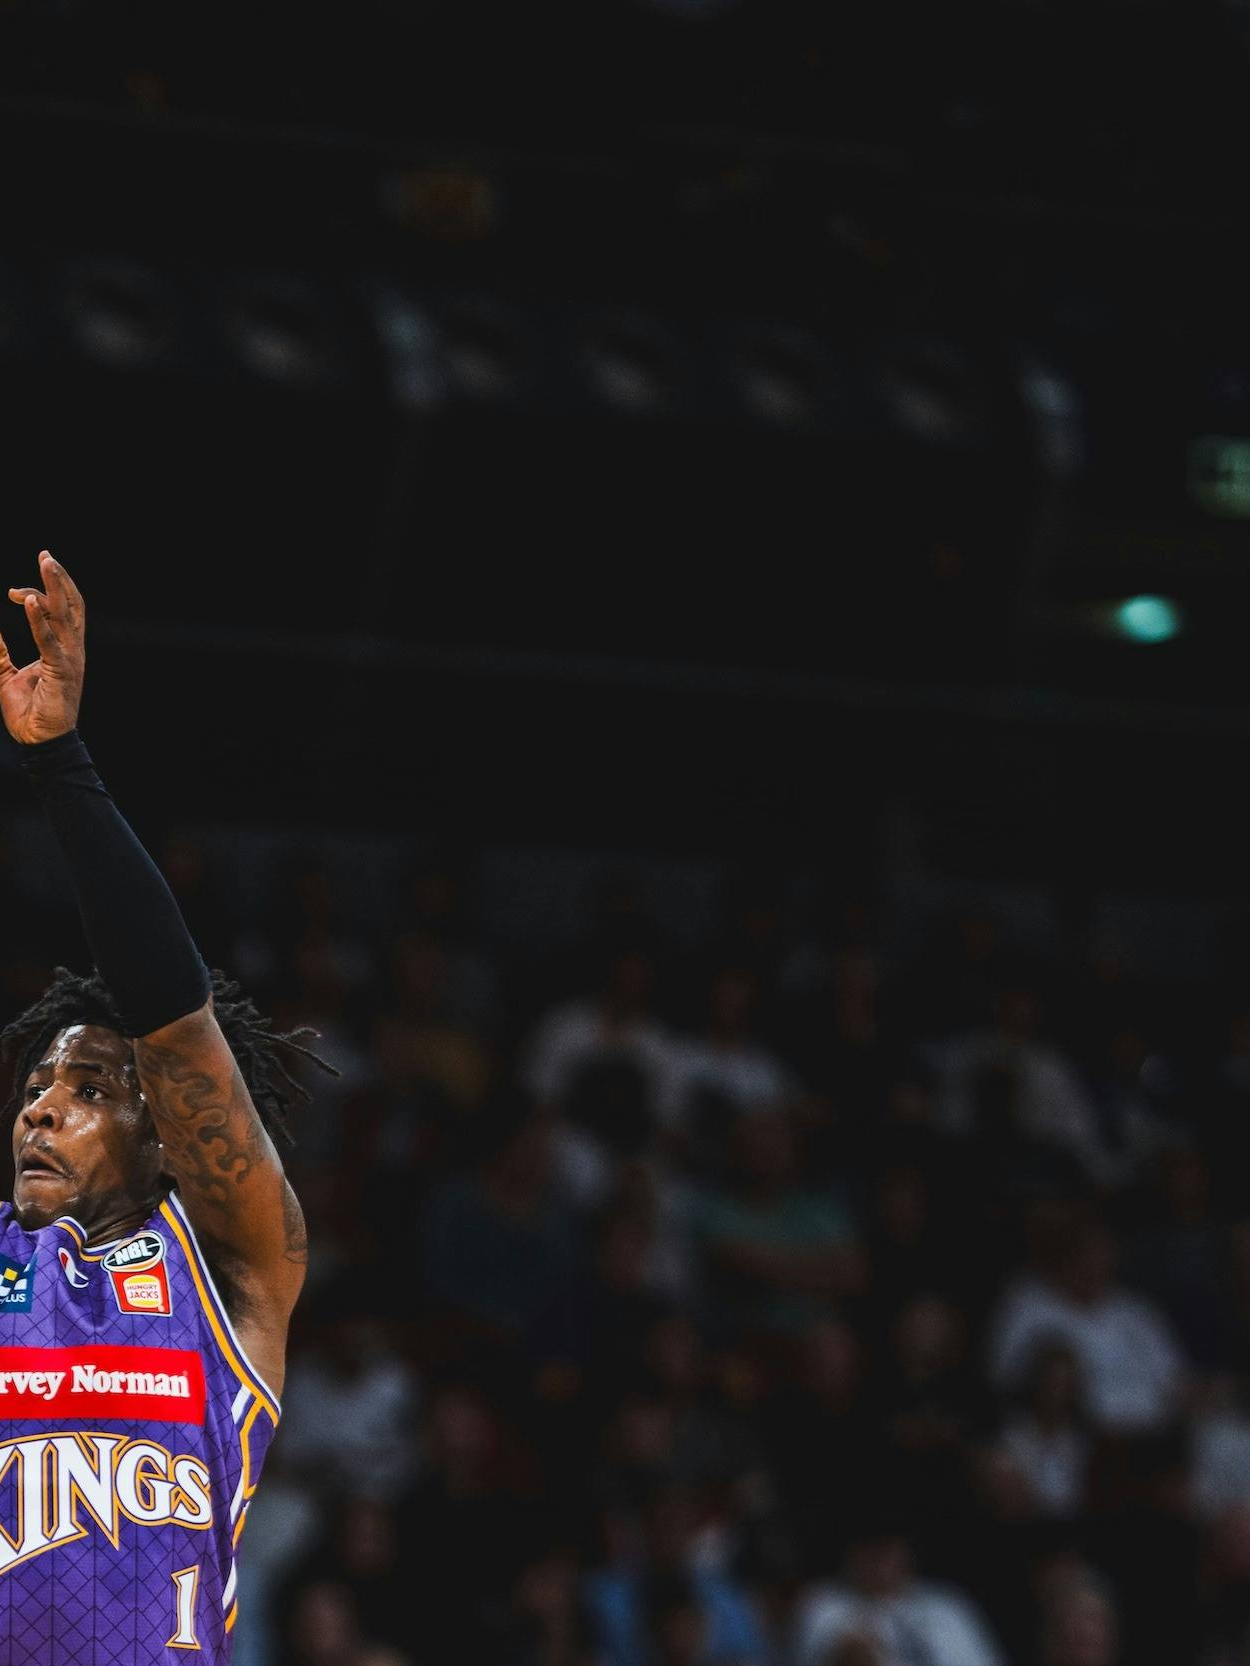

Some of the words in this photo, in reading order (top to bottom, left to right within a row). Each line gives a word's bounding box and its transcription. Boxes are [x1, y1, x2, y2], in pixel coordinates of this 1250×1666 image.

[114, 1240, 153, 1265] NBL
[126, 1283, 157, 1291] HUNGRY
[70, 1364, 190, 1398] Norman
[166, 1566, 201, 1650] 1
